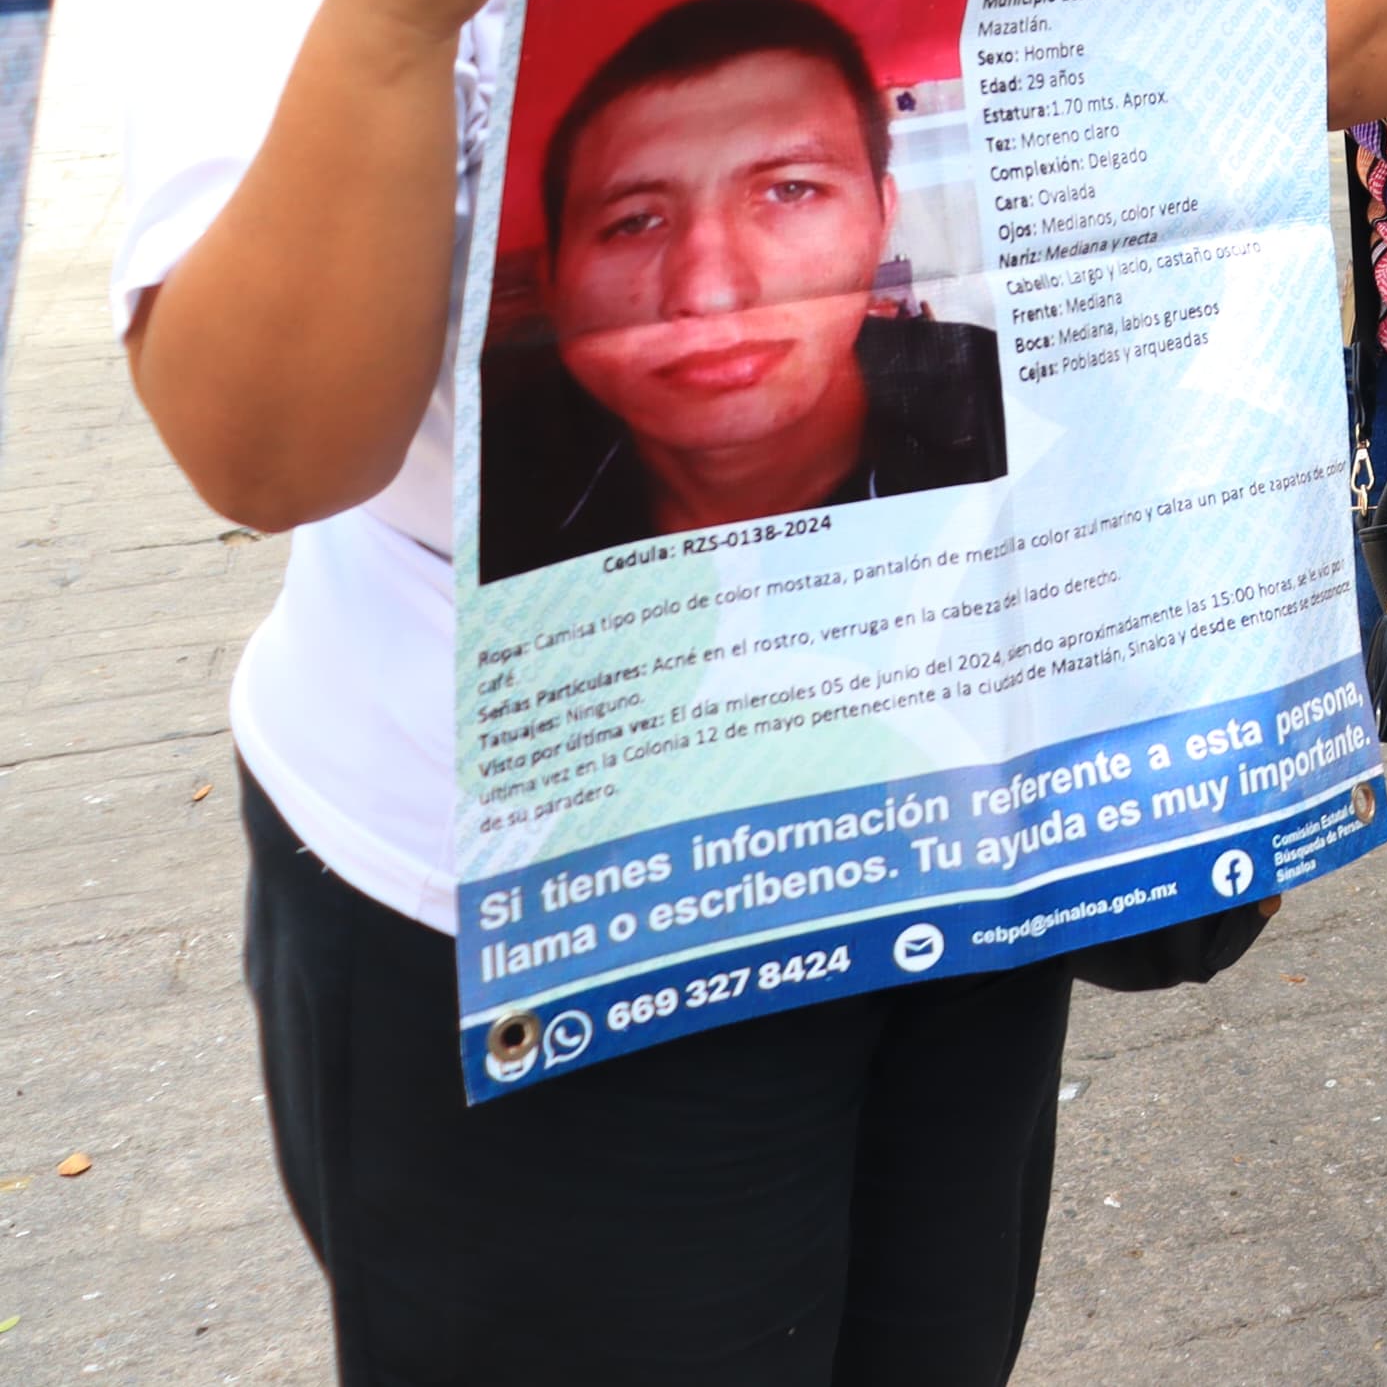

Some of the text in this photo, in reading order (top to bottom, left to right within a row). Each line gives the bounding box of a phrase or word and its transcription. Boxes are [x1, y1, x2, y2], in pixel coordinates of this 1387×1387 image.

[978, 13, 1052, 38] Mazatlán.
[980, 70, 1085, 95] Edad: 29 años
[603, 514, 832, 575] Cedula: RZS-0138-2024
[478, 681, 1365, 932] Si tienes información referente a esta persona,
[480, 723, 1372, 983] llama o escribenos. Tu ayuda es muy importante.
[972, 880, 1178, 947] cebpd@sinaloa.gob.mx
[605, 945, 852, 1032] 669 327 8424
